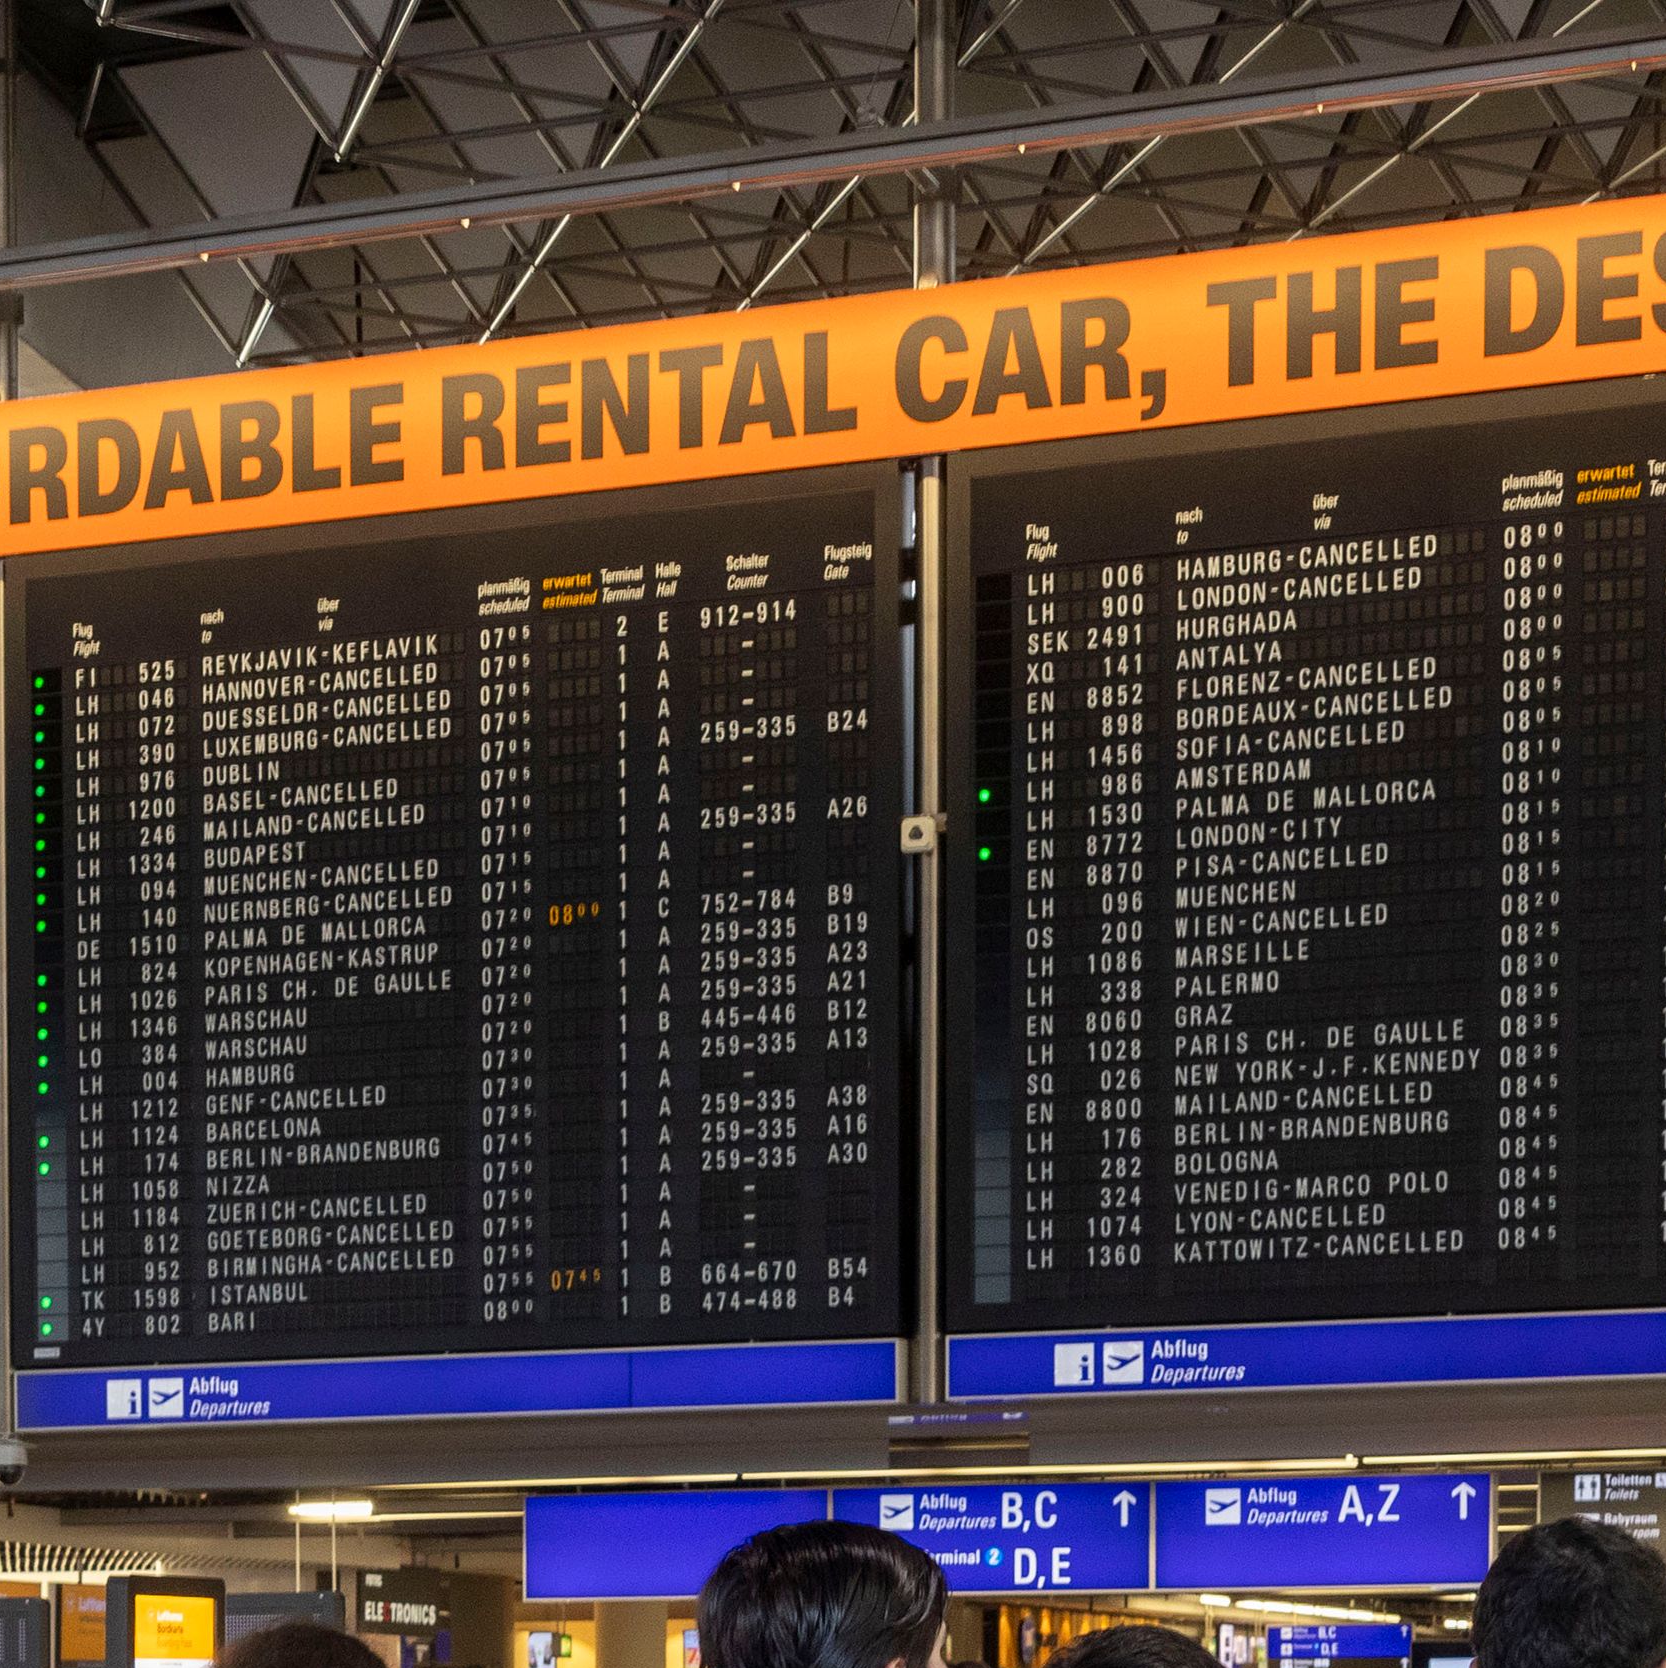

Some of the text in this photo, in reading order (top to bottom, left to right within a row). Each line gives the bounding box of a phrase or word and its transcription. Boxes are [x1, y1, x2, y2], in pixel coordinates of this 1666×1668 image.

[441, 333, 858, 477] RENTAL
[895, 298, 1167, 424] CAR,
[1207, 257, 1439, 388] THE
[1176, 533, 1437, 582] HAMBURG-CANCELLED
[74, 598, 797, 690] FI 525 REYKJAVIK-KEFLAVIK 912-914
[1027, 629, 1069, 656] SEK
[1086, 622, 1142, 651] 2491
[1176, 608, 1298, 642] HURGHADA
[1175, 685, 1453, 731] BORDEAUX-CANCELLED
[202, 716, 452, 760] LUXEMBURG-CANCELLED
[202, 707, 868, 788] DUBLIN 259-335 B24
[1176, 815, 1342, 850] LONDON-CITY
[203, 885, 453, 924] NUERNBERG-CANCELLED
[1175, 937, 1310, 969] MARSEILLE
[204, 1006, 308, 1034] WARSCHAU
[1025, 1072, 1054, 1096] SQ
[1099, 1067, 1142, 1092] 026
[1174, 1063, 1219, 1087] NEW
[1235, 1047, 1481, 1084] YORK-J.F.KENNEDY
[205, 1136, 440, 1171] BERLIN-BRANDENBURG
[1173, 1170, 1449, 1205] VENEDIG-MARCO POLO
[206, 1246, 454, 1279] BIRMINGHA-CANCELLED
[1173, 1228, 1464, 1264] KATTOWITZ-CANCELLED
[81, 1259, 797, 1311] TK 1598 ISTANBUL 664-670
[1151, 1338, 1209, 1362] Abflug
[190, 1376, 238, 1397] Abflug
[1151, 1363, 1246, 1387] Departures
[190, 1399, 271, 1420] Departures
[1604, 1472, 1653, 1487] Toiletten
[1604, 1487, 1640, 1501] Toilets
[919, 1490, 1059, 1533] Abflug B,C
[1247, 1483, 1401, 1527] Abflug A,Z
[1247, 1507, 1330, 1526] Departures
[1604, 1512, 1658, 1528] Babyraum
[919, 1514, 998, 1533] Departures
[1014, 1547, 1073, 1589] D,E
